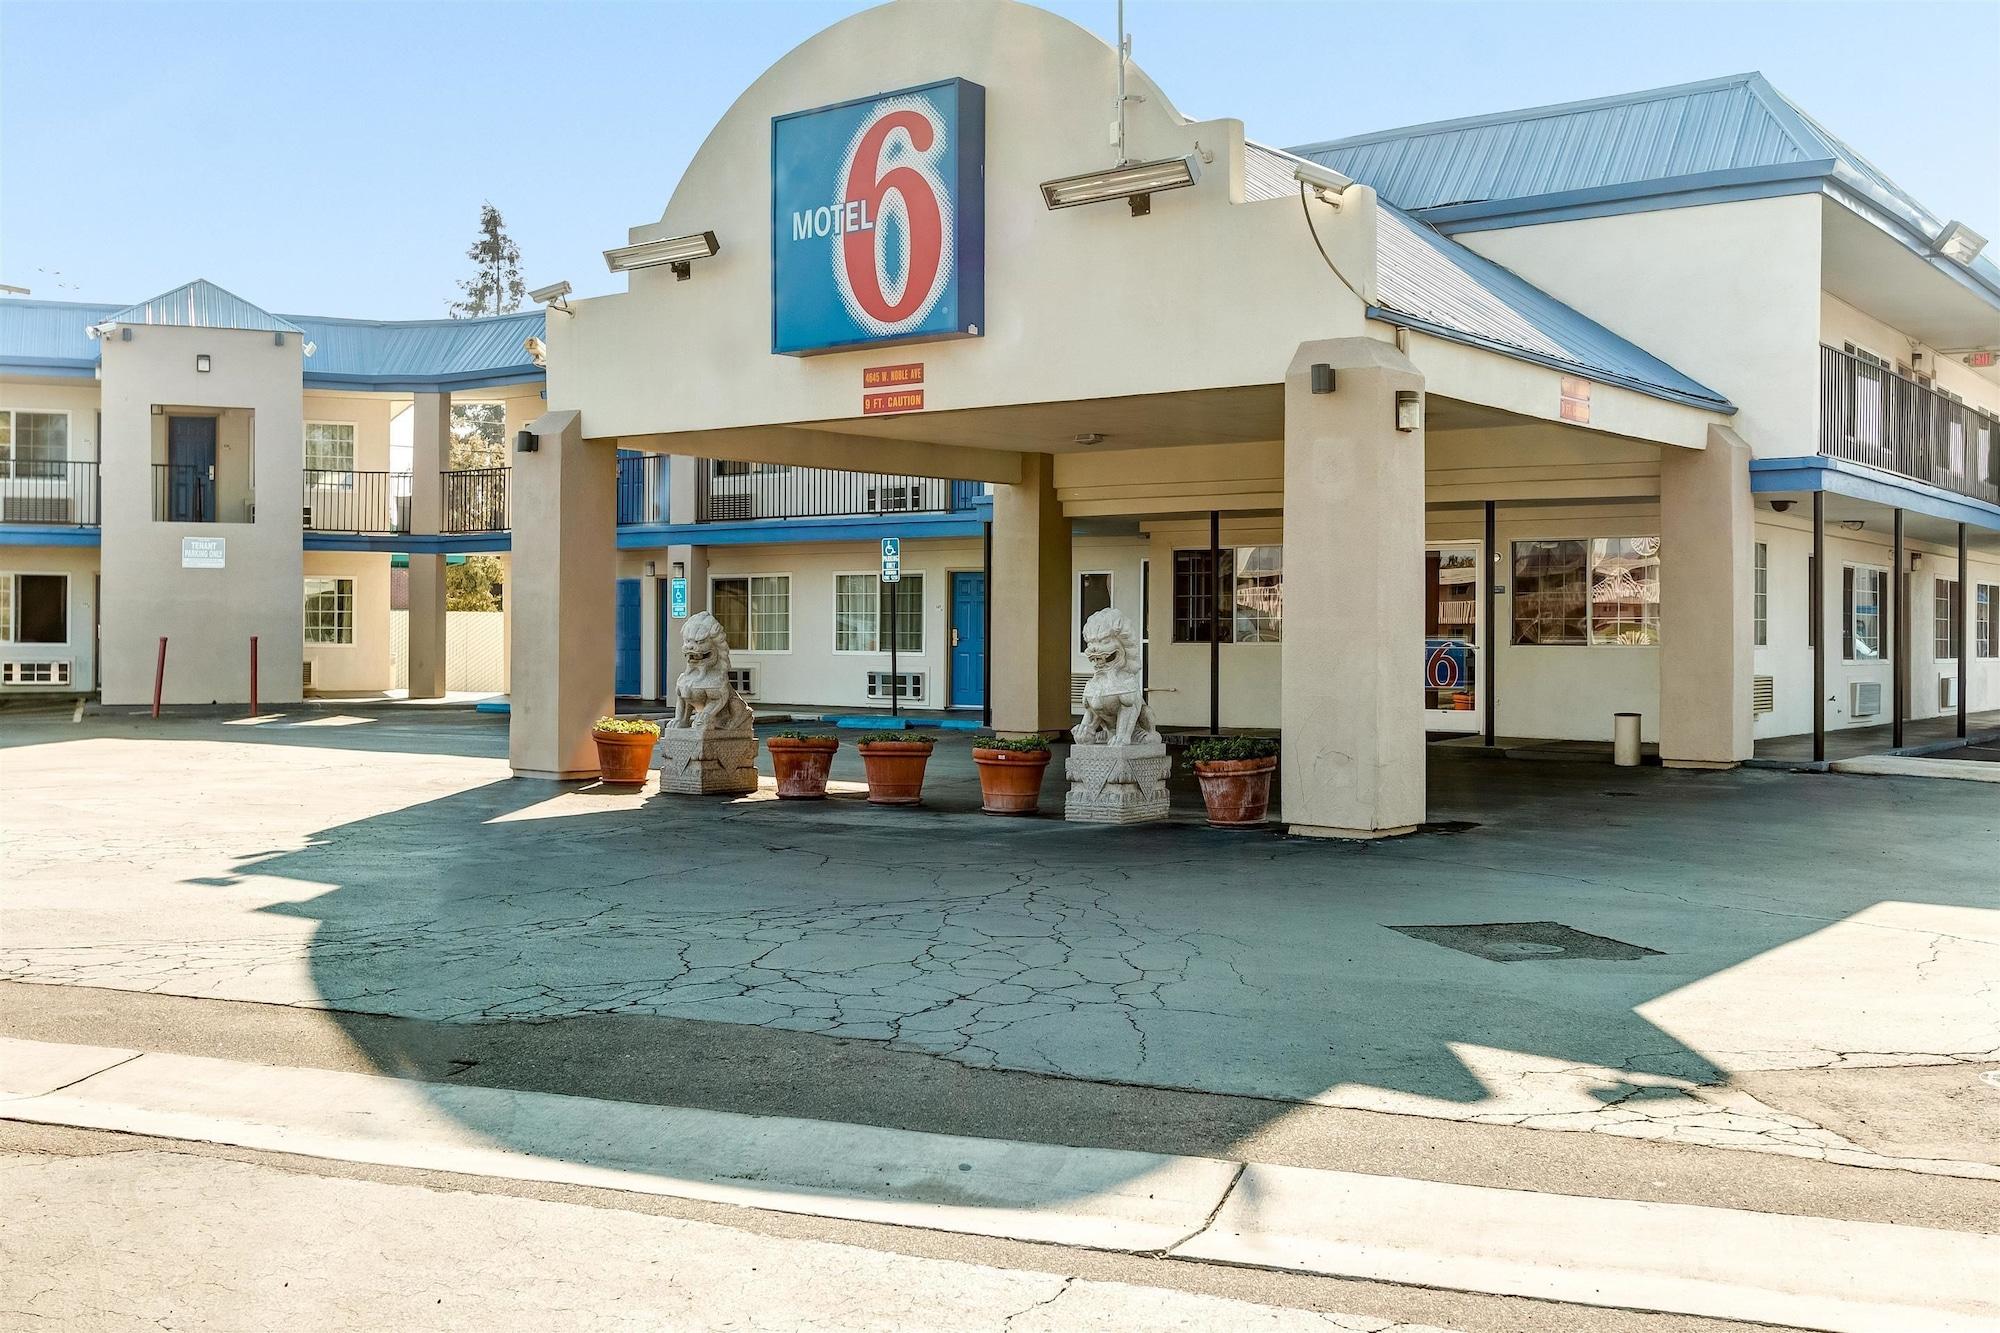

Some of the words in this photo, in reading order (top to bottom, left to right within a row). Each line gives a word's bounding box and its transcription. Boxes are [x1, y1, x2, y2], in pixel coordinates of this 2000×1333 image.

[793, 199, 873, 241] MOTEL
[843, 110, 942, 323] 6
[1974, 352, 1990, 365] EXIT
[891, 369, 908, 381] NOBLE
[910, 368, 921, 380] AVE
[865, 399, 870, 410] 9
[873, 398, 885, 409] FT.
[887, 394, 921, 408] CAUTION
[191, 541, 217, 550] TENANT
[184, 549, 208, 558] PARKING
[209, 550, 223, 558] ONLY
[1427, 641, 1459, 688] 6
